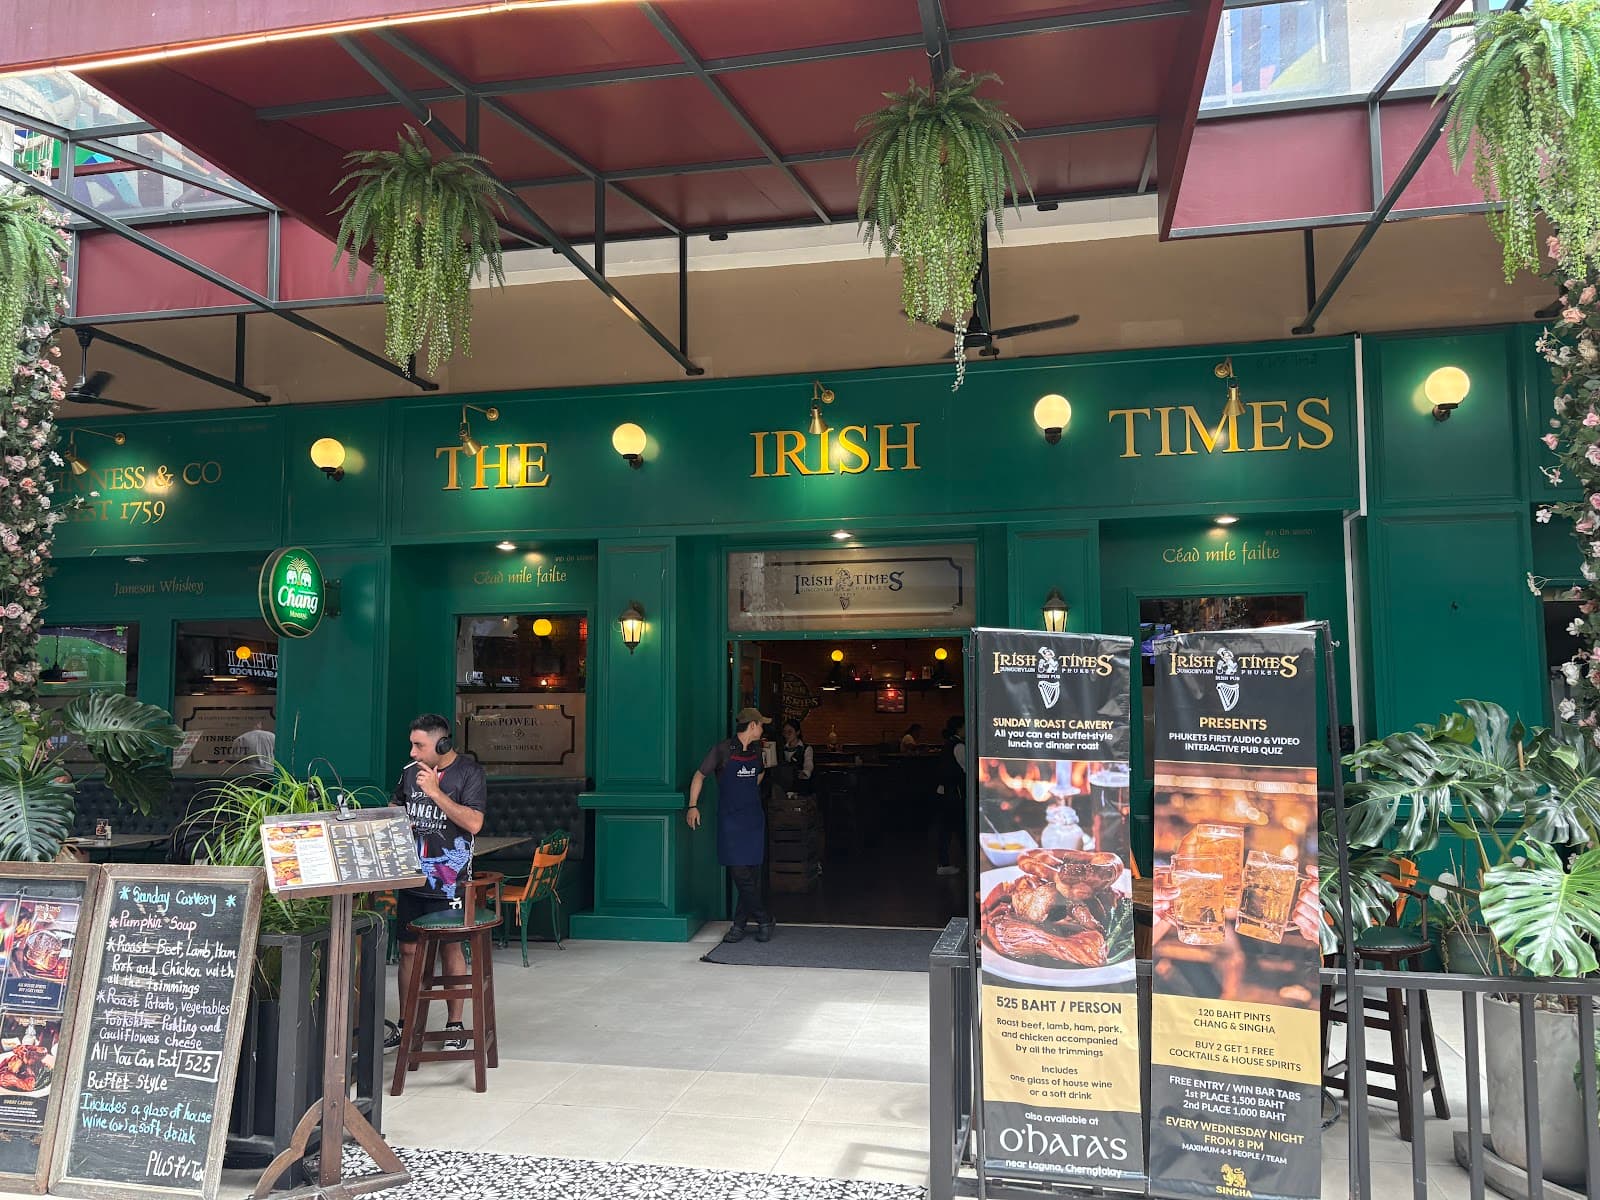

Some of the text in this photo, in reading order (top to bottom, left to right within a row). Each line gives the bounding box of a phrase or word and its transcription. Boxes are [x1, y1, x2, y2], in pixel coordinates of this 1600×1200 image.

[435, 397, 1334, 490] THE IRISH TIMES
[154, 465, 174, 489] &
[182, 461, 222, 486] CO
[120, 500, 167, 525] 1759
[114, 575, 205, 597] Jameson Whiskey
[278, 585, 319, 614] Chang
[993, 717, 1114, 730] SUNDAY ROAST CARVERY
[1199, 716, 1268, 731] PRESENTS
[994, 729, 1113, 742] All you can eat buffet-style
[1168, 732, 1300, 746] PHUKETS FIRST AUDIO & VIDEO
[1008, 739, 1100, 750] lunch or dinner roast
[1185, 743, 1283, 755] INTERACTIVE PUB QUIZ
[120, 910, 197, 940] Pumpkin Soup
[111, 953, 236, 978] Pork and Chicken with
[106, 973, 200, 1000] all the trimmings
[107, 987, 140, 1008] Roast
[996, 995, 1122, 1014] 525 BAHT / PERSON
[997, 1017, 1019, 1027] Roast
[1021, 1020, 1045, 1030] beef,
[1198, 1008, 1271, 1022] 120 BAHT PINTS
[200, 1016, 221, 1033] and
[1193, 1018, 1276, 1034] CHANG & SINGHA
[1002, 1030, 1118, 1046] and chicken accompanied
[91, 1041, 213, 1073] All You Can Eat 525
[1015, 1043, 1104, 1058] by all the trimmings
[1195, 1040, 1275, 1057] BUY 2 GET 1 FREE
[1169, 1048, 1302, 1072] COCKTAILS & HOUSE SPIRITS
[1041, 1065, 1079, 1075] Includes
[1010, 1074, 1113, 1088] one glass of house wine
[1169, 1075, 1301, 1101] FREE ENTRY / WIN BAR TABS
[1049, 1090, 1067, 1098] soft
[1068, 1091, 1093, 1100] drink
[1184, 1089, 1285, 1110] 1st PLACE 1,500 BAHT
[80, 1092, 213, 1124] Includes glass house
[1183, 1099, 1287, 1122] 2nd PLACE 1,000 BAHT
[1025, 1112, 1099, 1126] also available at
[128, 1119, 196, 1145] a soft drink
[1165, 1115, 1305, 1145] EVERY WEDNESDAY NIGHT
[1204, 1134, 1264, 1151] FROM 8 PM
[1182, 1142, 1288, 1165] MAXIMUM 4-5 PEOPLE TEAM
[1005, 1160, 1027, 1169] near
[1215, 1185, 1253, 1198] SINGHA
